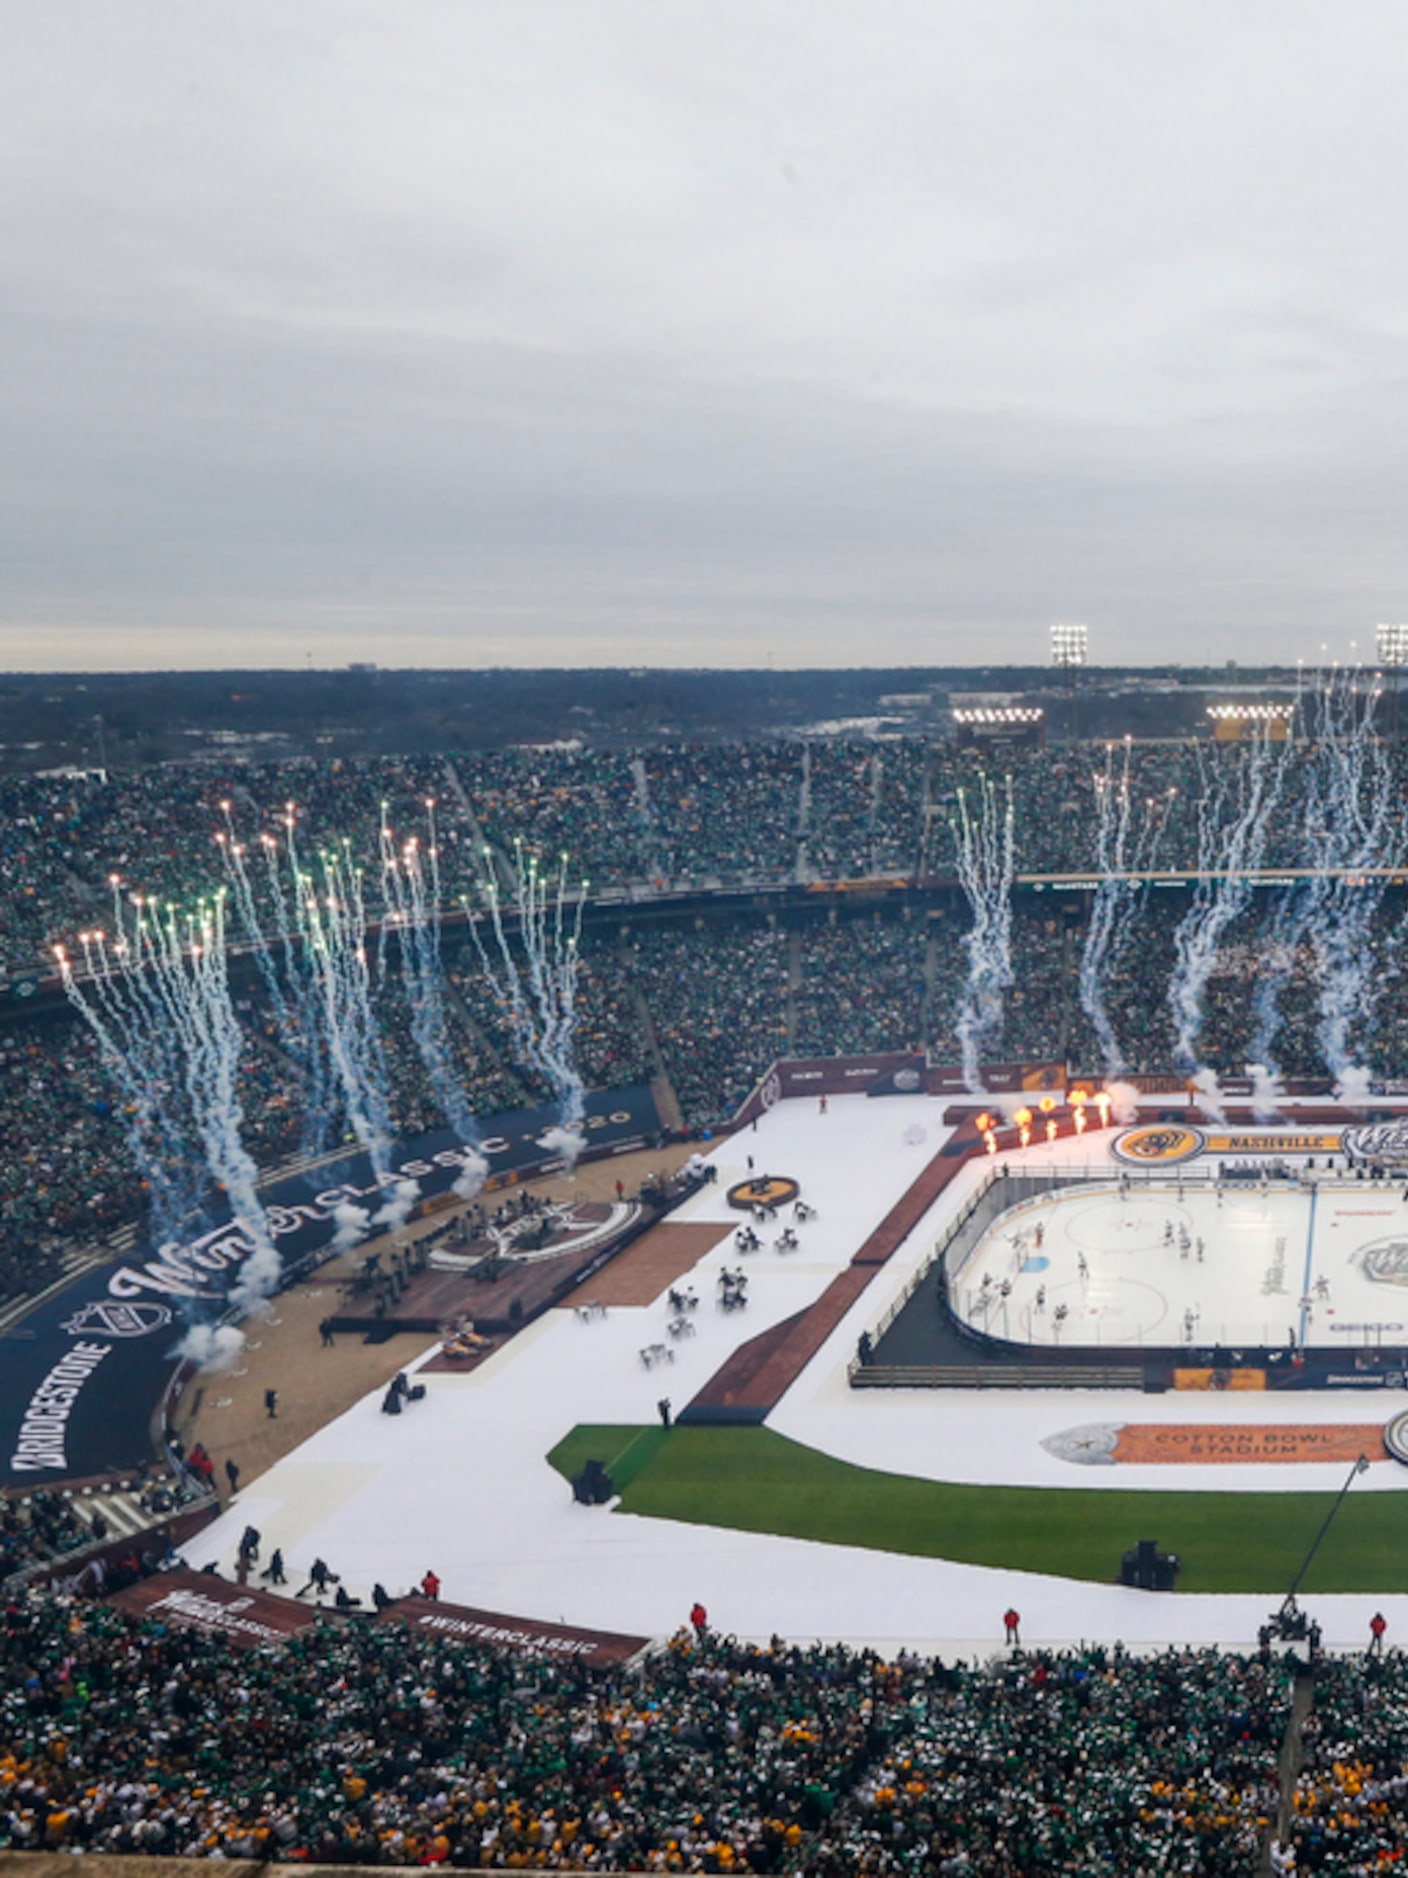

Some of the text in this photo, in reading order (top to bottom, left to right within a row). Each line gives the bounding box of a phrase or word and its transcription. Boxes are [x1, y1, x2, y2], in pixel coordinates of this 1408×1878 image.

[541, 1110, 632, 1134] 020
[1228, 1135, 1325, 1150] NASHVILLE
[11, 1340, 113, 1470] BRIDGESTONE
[1155, 1432, 1335, 1444] COTTON BOWL
[1190, 1444, 1298, 1456] STADIUM
[418, 1615, 599, 1655] #WINTERCLASSIC
